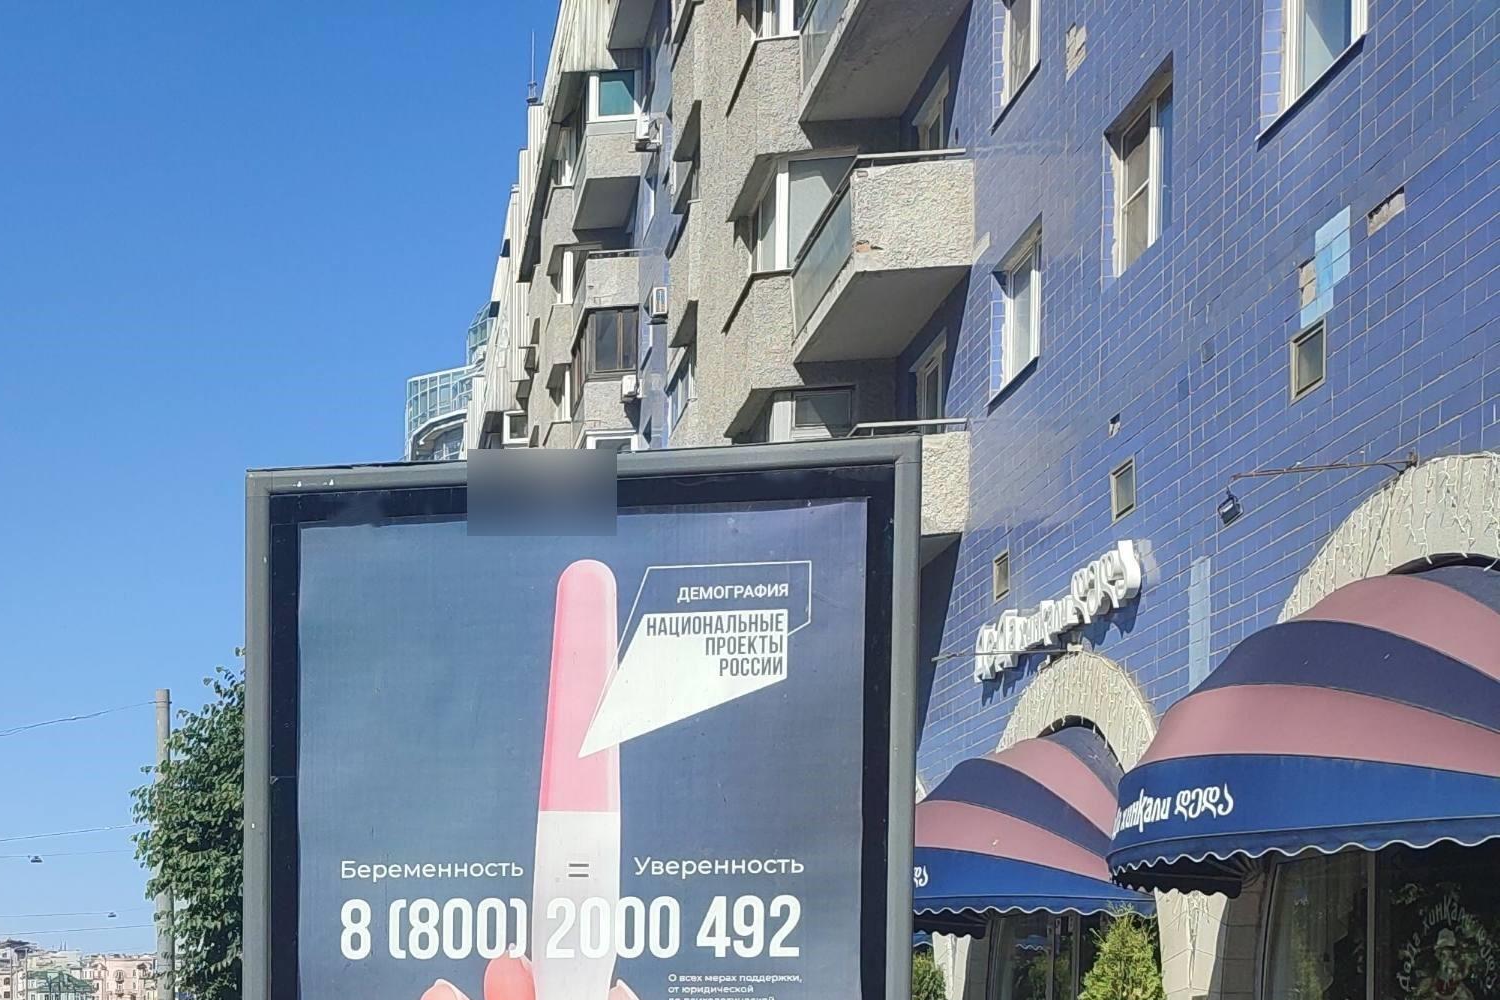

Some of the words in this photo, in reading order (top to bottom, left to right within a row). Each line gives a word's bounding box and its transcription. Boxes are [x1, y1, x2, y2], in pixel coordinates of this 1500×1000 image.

[677, 583, 789, 604] ДЕМОГРАФИЯ
[646, 613, 784, 637] НАЦИОНАЛЬНЫЕ
[705, 635, 784, 656] ПРОЕКТЫ
[719, 656, 783, 677] РОССИИ
[340, 860, 524, 883] Беременность
[634, 856, 805, 880] Уверенность
[339, 897, 372, 960] 8
[388, 896, 528, 960] (800)
[546, 895, 681, 960] 2000
[695, 894, 801, 959] 492
[668, 973, 678, 982] О
[679, 974, 703, 983] всех
[704, 974, 737, 984] мерах
[739, 973, 803, 984] поддержки,
[667, 986, 680, 994] от
[682, 984, 754, 996] юридической
